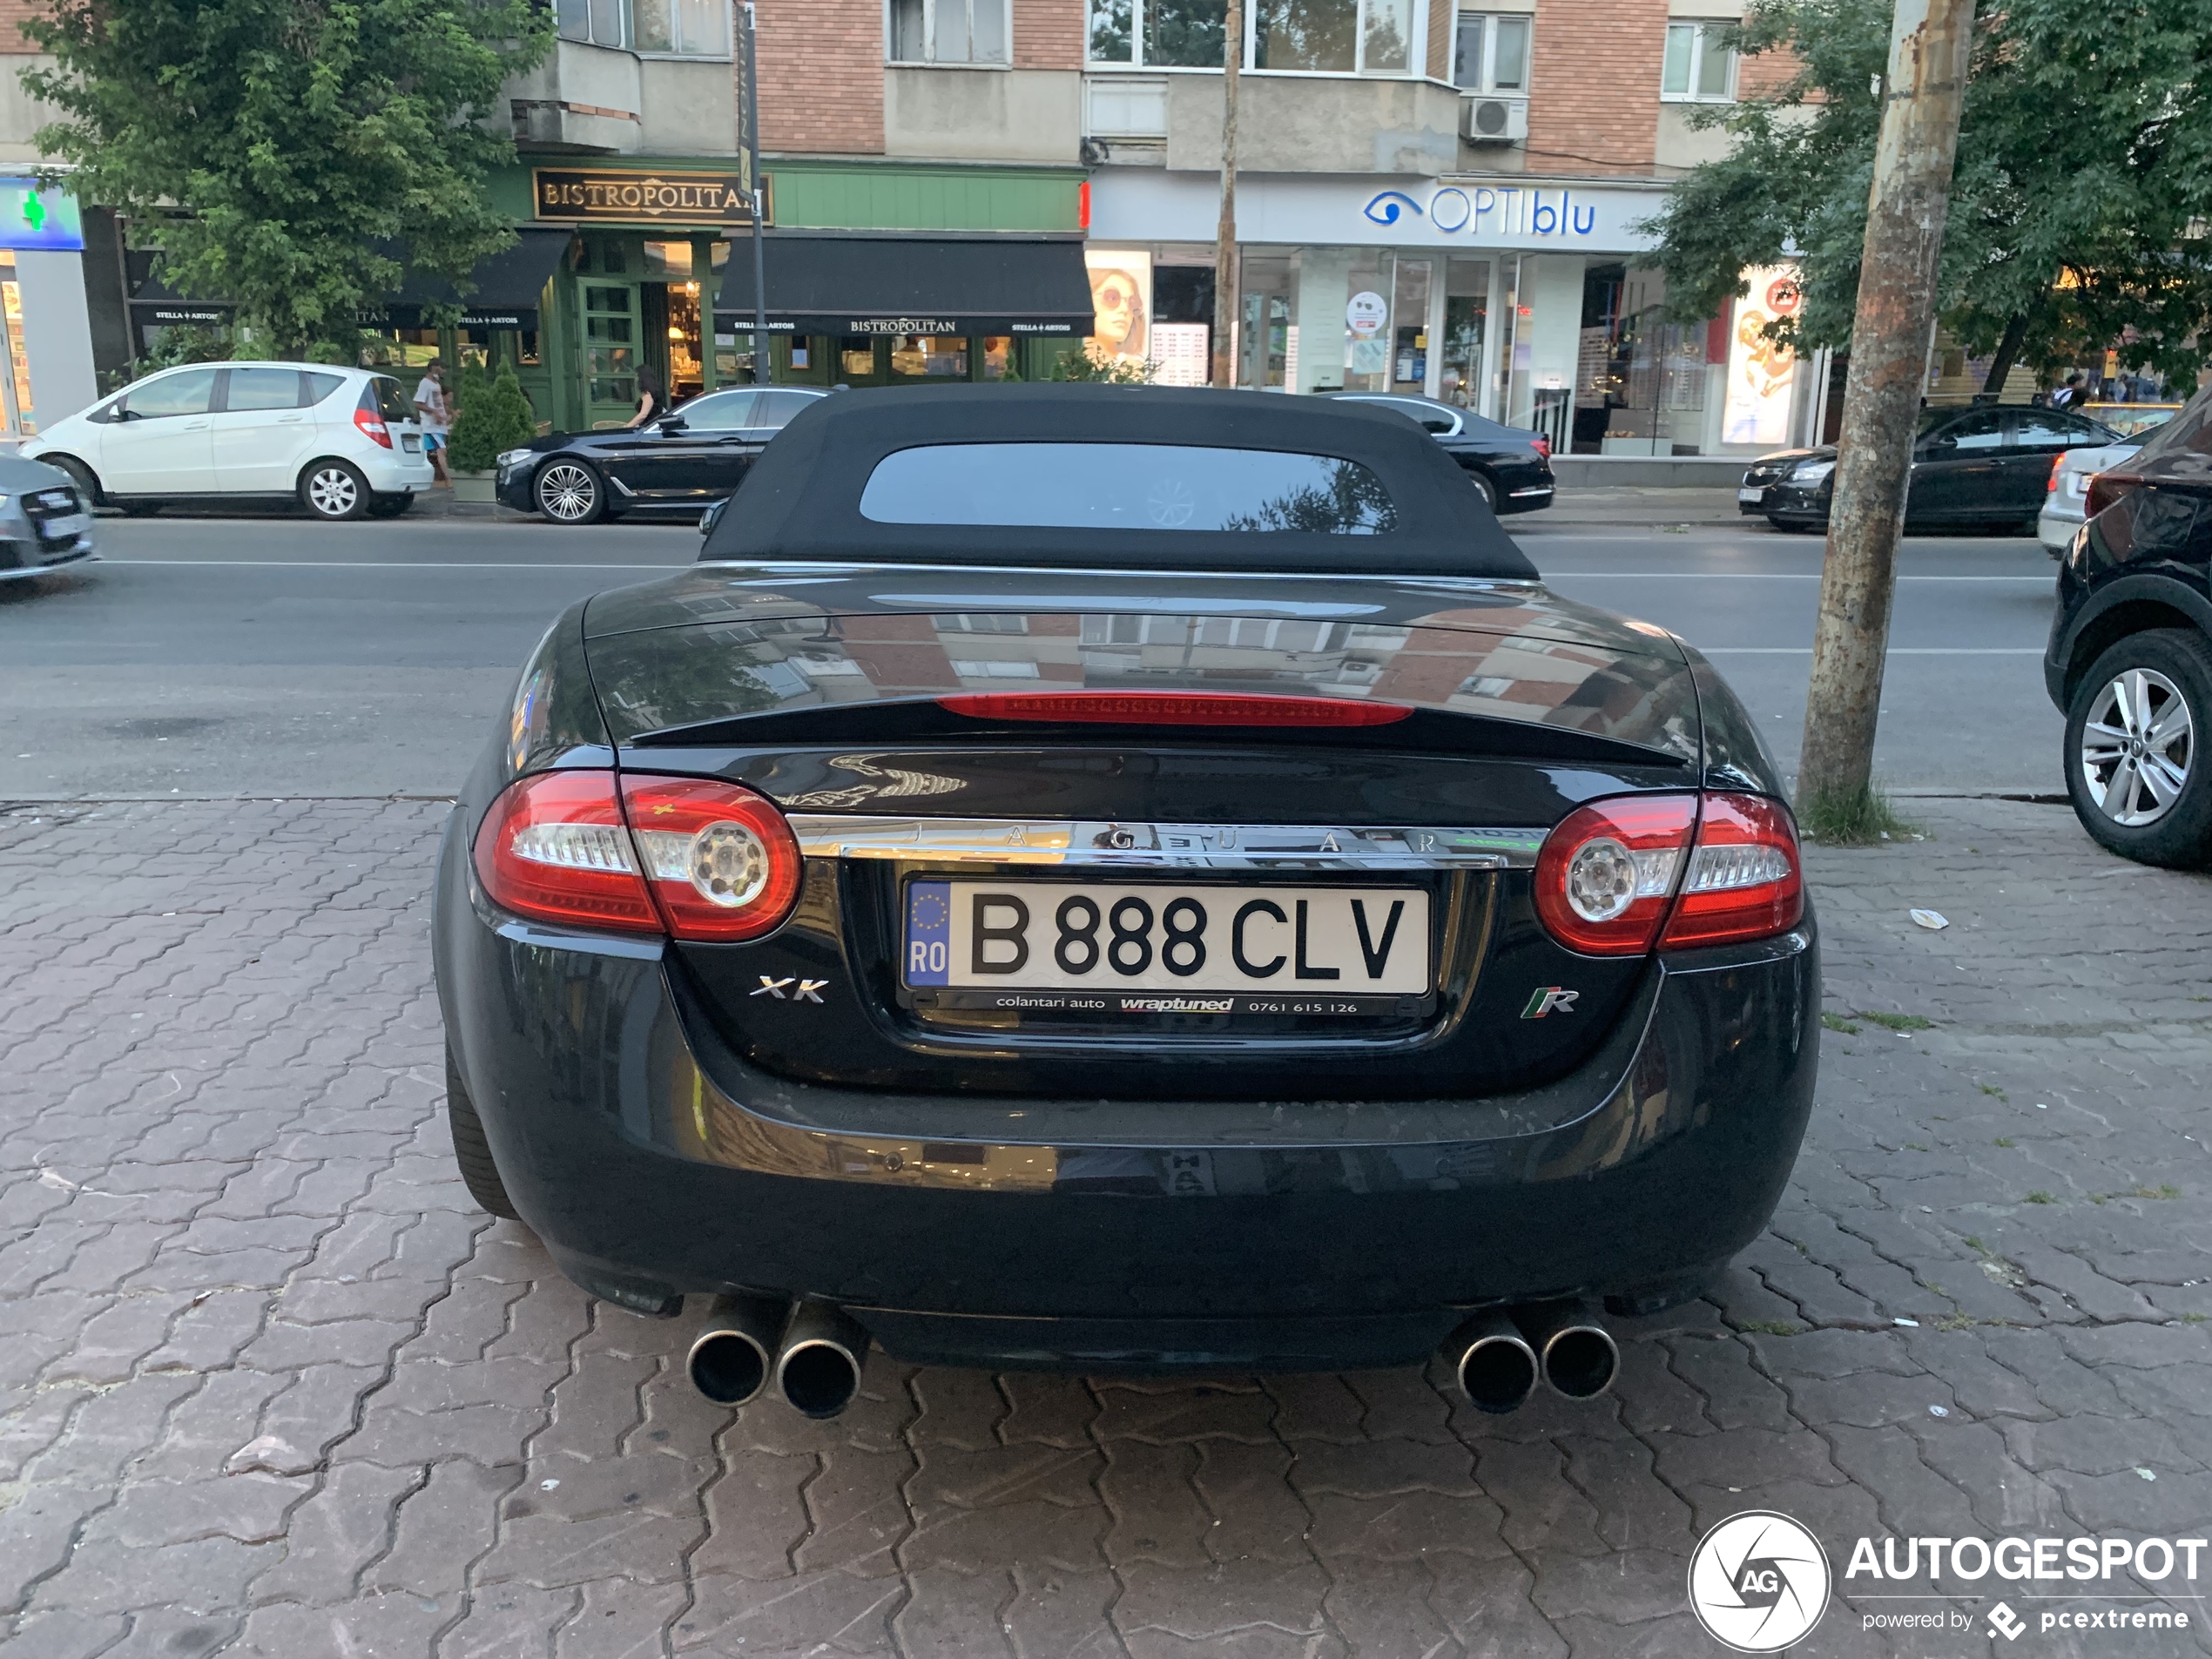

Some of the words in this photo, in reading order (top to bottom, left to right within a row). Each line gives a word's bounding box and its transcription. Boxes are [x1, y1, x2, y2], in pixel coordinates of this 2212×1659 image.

[1431, 187, 1595, 235] OPTIblu
[851, 320, 955, 332] BISTROPOLITAN
[972, 894, 1029, 974] B
[1054, 895, 1208, 977] 888
[1232, 899, 1406, 980] CLV
[910, 941, 946, 973] RO
[749, 975, 829, 1003] XK
[996, 996, 1065, 1008] colantari
[1069, 998, 1105, 1008] auto
[1121, 998, 1234, 1013] wraptuned
[1249, 1002, 1285, 1012] 0761
[1293, 1003, 1322, 1013] 615
[1331, 1004, 1357, 1013] 126
